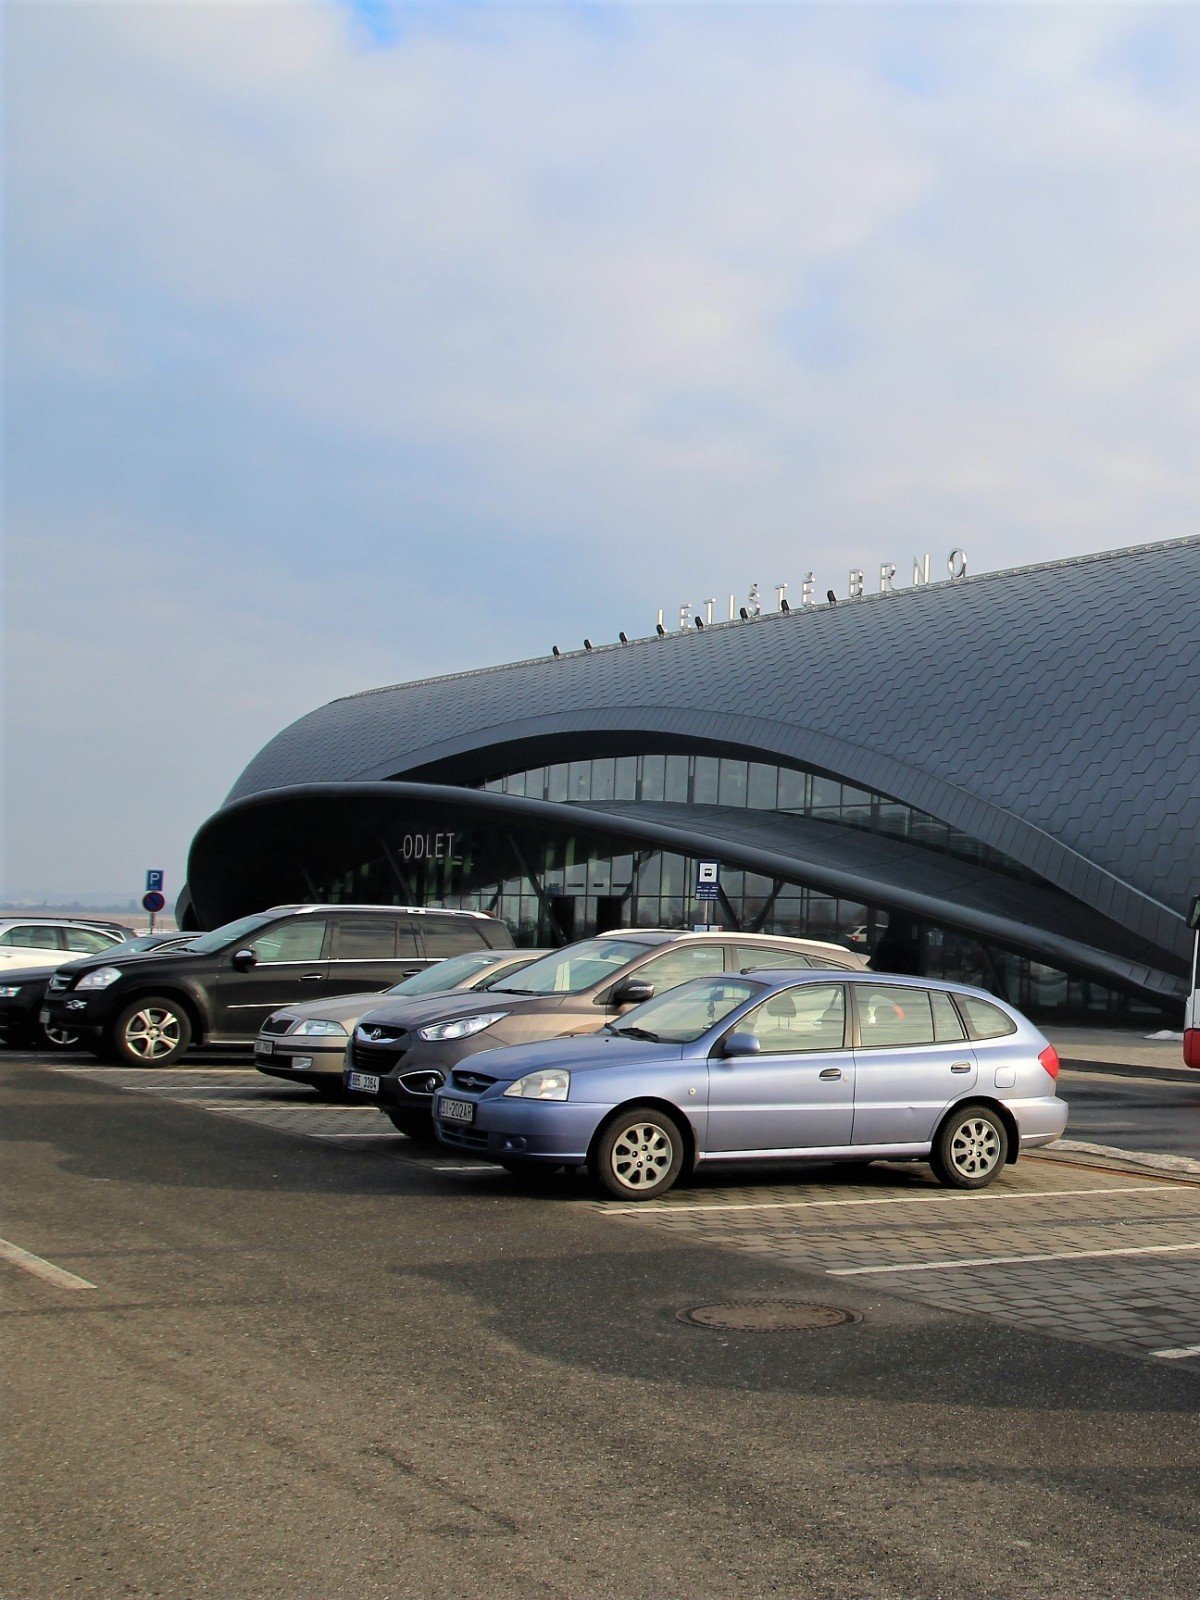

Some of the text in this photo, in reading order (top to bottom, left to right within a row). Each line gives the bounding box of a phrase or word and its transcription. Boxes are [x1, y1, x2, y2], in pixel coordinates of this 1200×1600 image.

[849, 548, 968, 598] BRNO
[403, 832, 455, 859] ODLET
[150, 872, 160, 884] P
